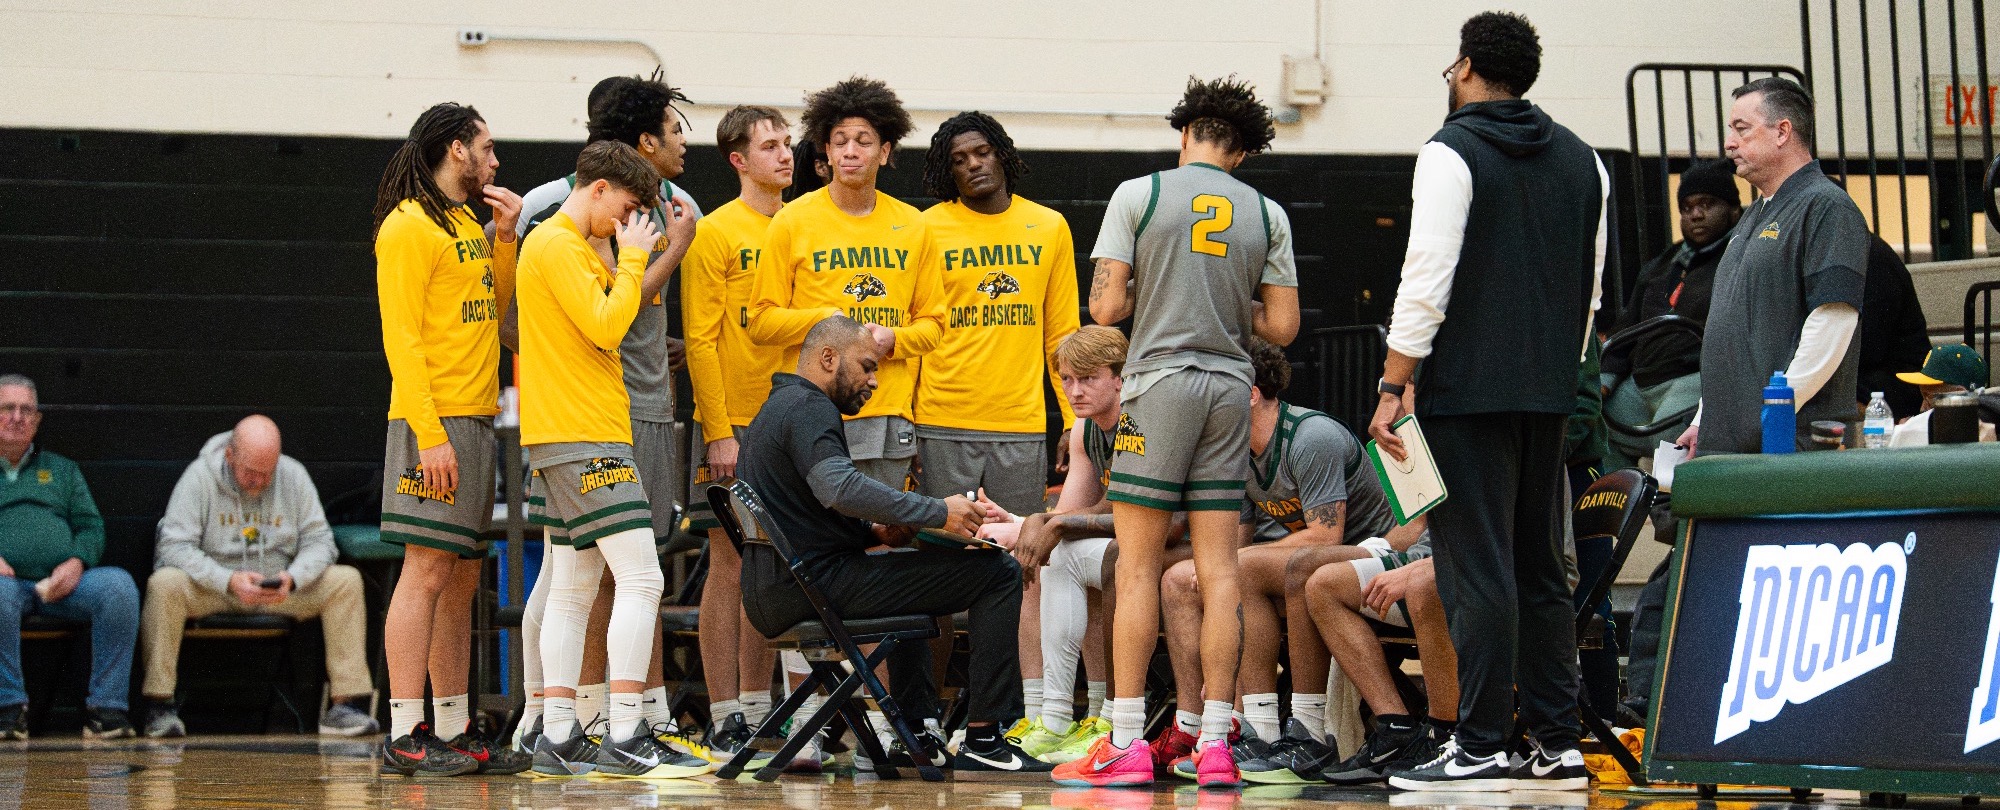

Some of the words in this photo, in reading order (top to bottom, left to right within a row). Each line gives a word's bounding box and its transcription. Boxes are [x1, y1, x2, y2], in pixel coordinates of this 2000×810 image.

[1191, 194, 1234, 258] 2
[813, 247, 909, 272] FAMILY
[945, 245, 1042, 271] FAMILY
[462, 299, 486, 323] DACC
[950, 306, 977, 328] DACC
[580, 467, 639, 495] JAGUARS
[1580, 492, 1627, 509] DANVILLE
[1728, 565, 1896, 717] NJCAA
